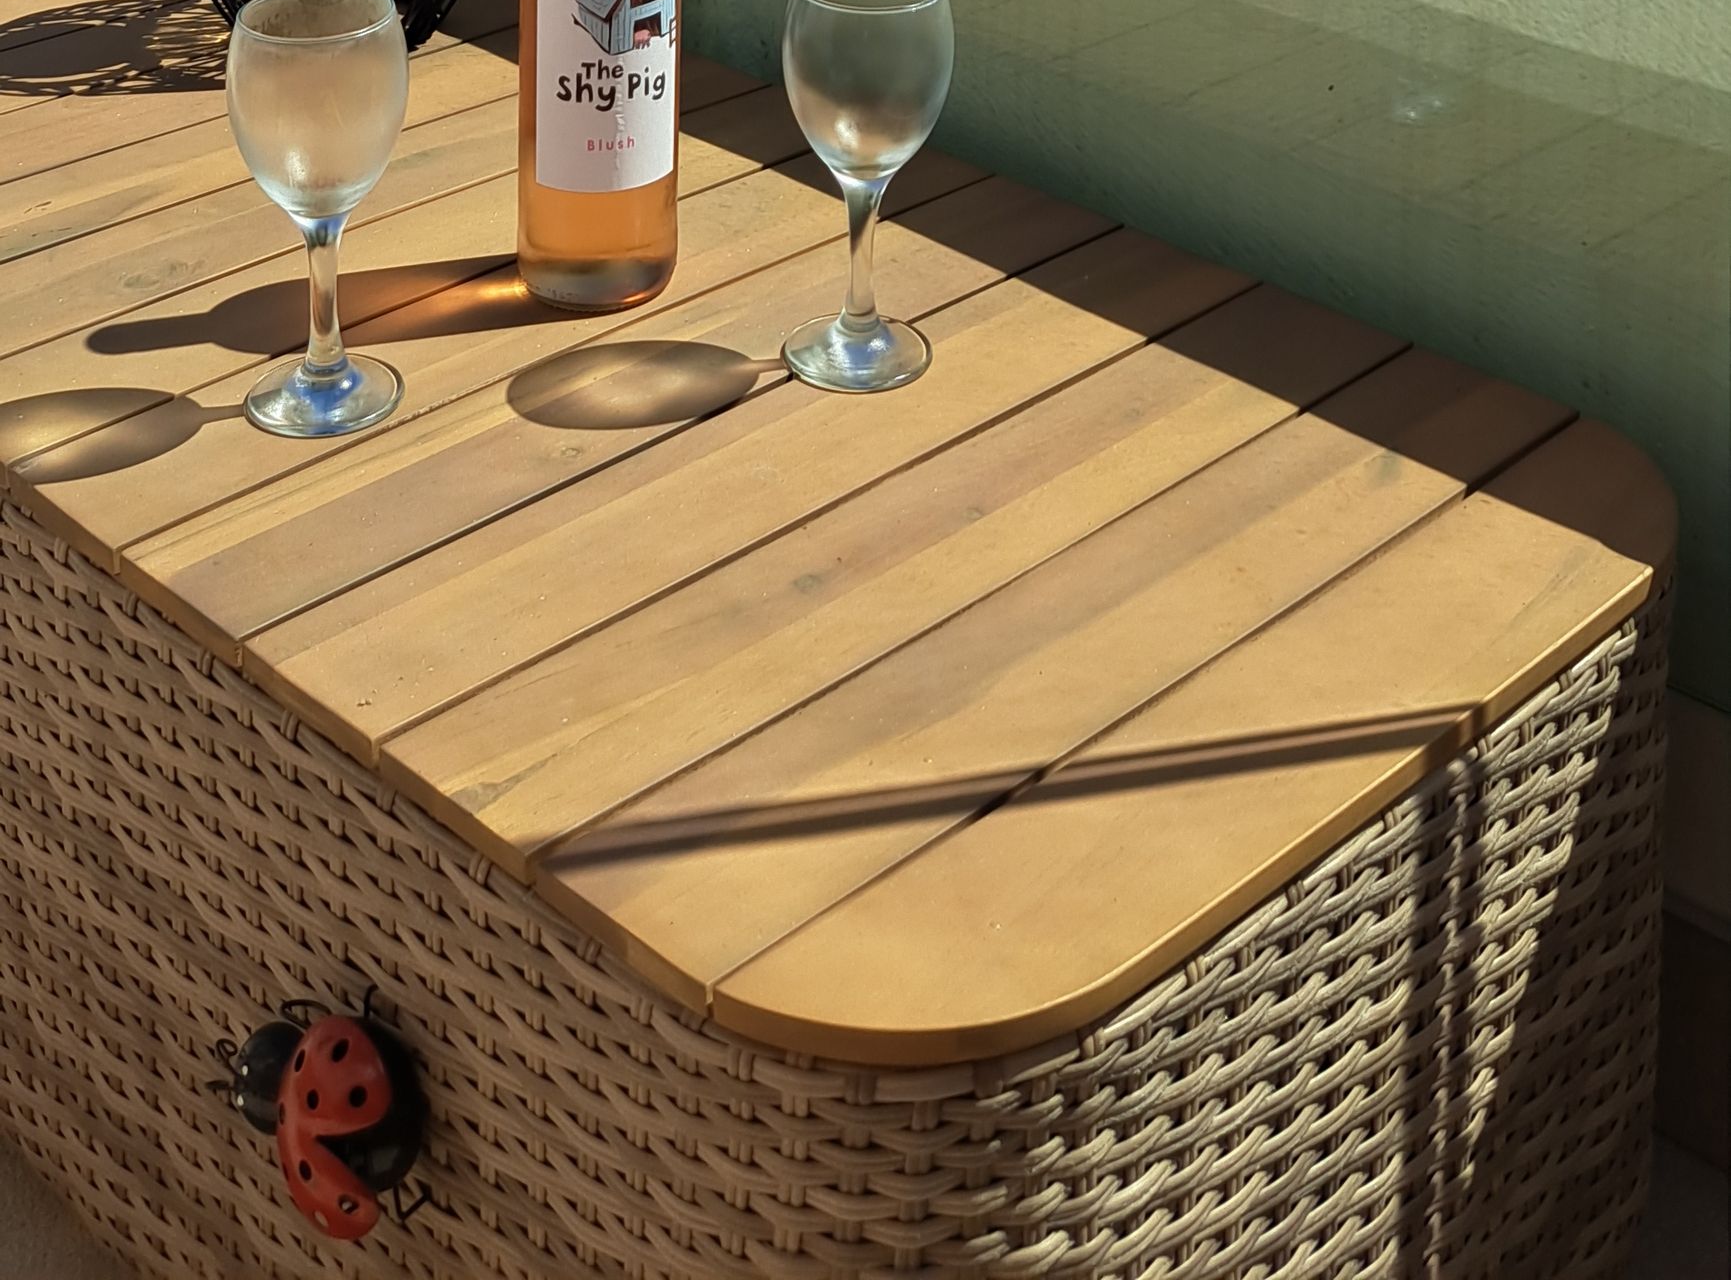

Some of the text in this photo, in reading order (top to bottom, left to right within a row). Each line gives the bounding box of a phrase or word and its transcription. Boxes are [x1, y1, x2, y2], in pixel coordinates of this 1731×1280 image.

[581, 59, 624, 80] The
[556, 66, 666, 112] Shy Pig
[587, 136, 635, 151] Blush
